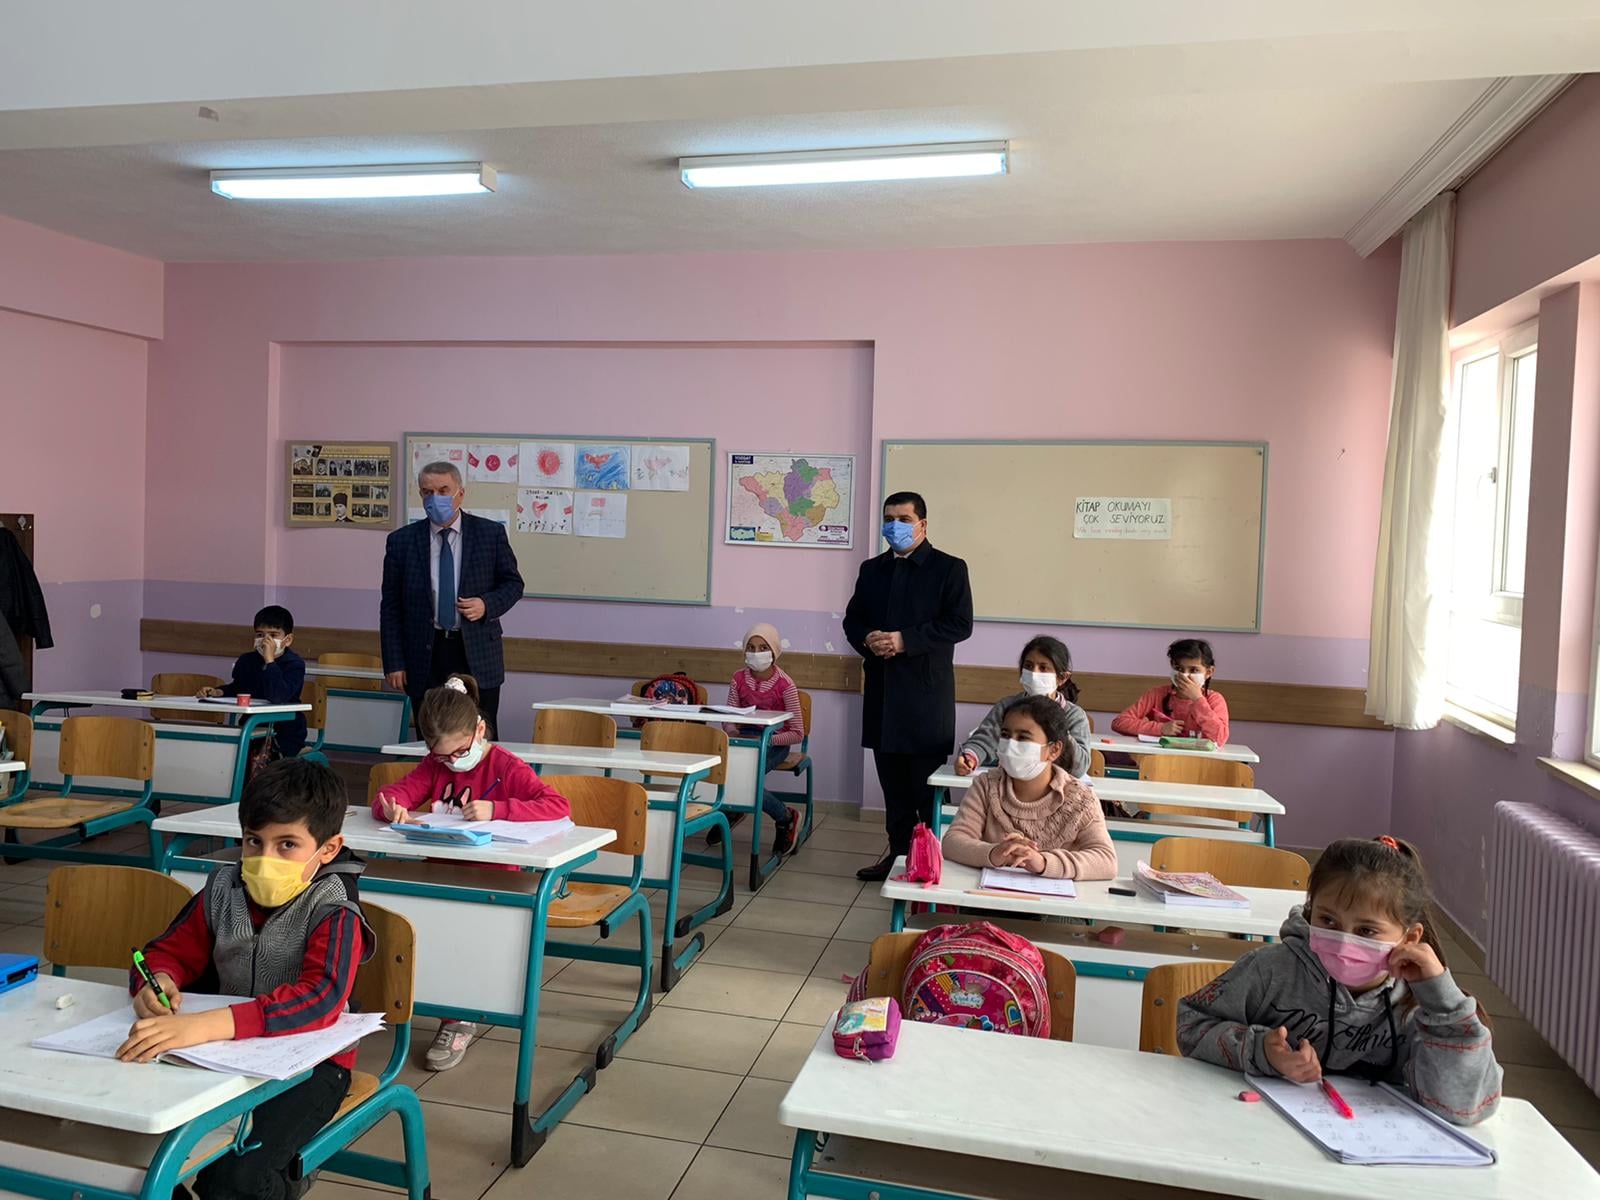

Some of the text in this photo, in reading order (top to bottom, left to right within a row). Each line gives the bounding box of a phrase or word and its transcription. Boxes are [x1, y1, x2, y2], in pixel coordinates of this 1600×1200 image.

[1076, 499, 1152, 514] KİTAP OKUMAYI
[1083, 512, 1165, 525] ÇOK SEVİYORUZ
